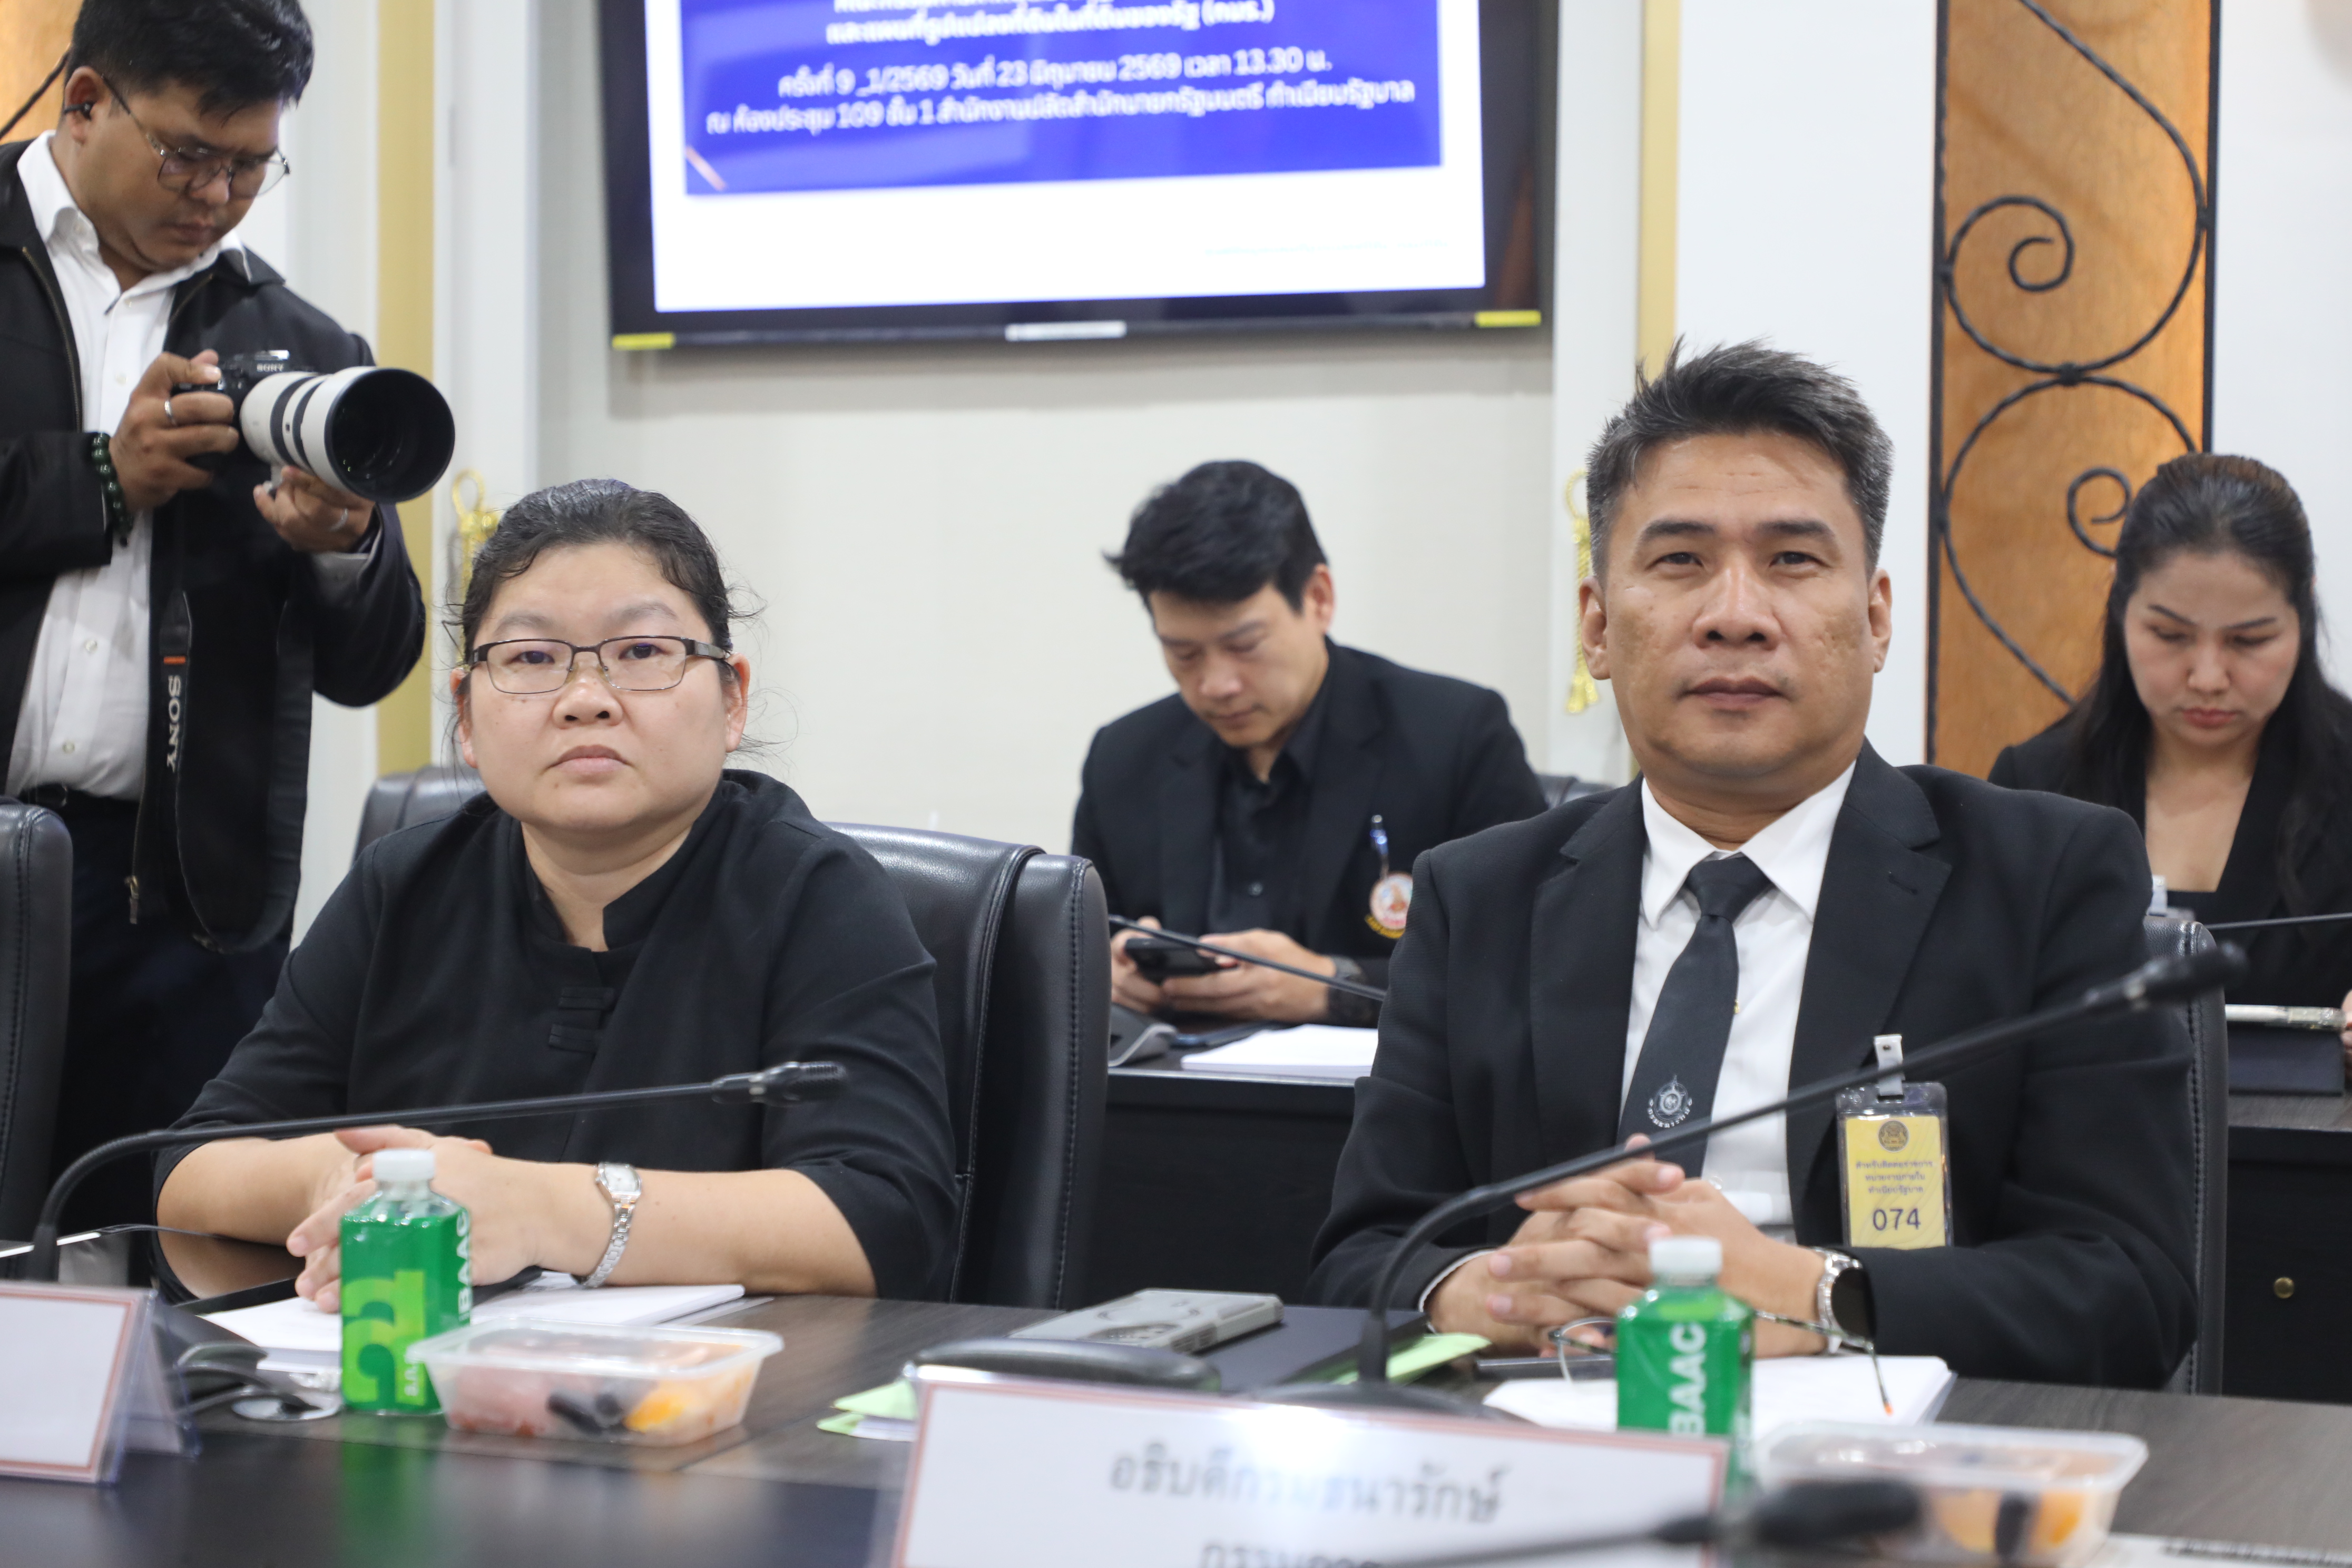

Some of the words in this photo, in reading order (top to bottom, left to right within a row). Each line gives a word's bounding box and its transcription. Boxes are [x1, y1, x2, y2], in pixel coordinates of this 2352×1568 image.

[779, 62, 835, 98] ครั้งที่
[949, 54, 995, 90] วันที่
[996, 60, 1028, 87] 23
[1029, 58, 1116, 91] มิถุนายน
[1117, 52, 1182, 82] 2569
[1183, 53, 1231, 79] เวลา
[1232, 46, 1304, 76] 13.30
[1305, 50, 1332, 72] น.
[733, 103, 836, 136] ห้องประชุม
[836, 101, 885, 128] 109
[886, 94, 917, 126] ชั้น
[918, 99, 935, 125] 1
[1265, 77, 1415, 110] ทำเนียบรัฐบาล
[257, 363, 284, 372] SONY
[166, 675, 182, 773] SONY
[1868, 1185, 1924, 1195] ทำเนียบรัฐบาล
[1873, 1208, 1922, 1231] 074
[456, 1212, 472, 1315] BAAC
[1668, 1321, 1707, 1435] BAAC
